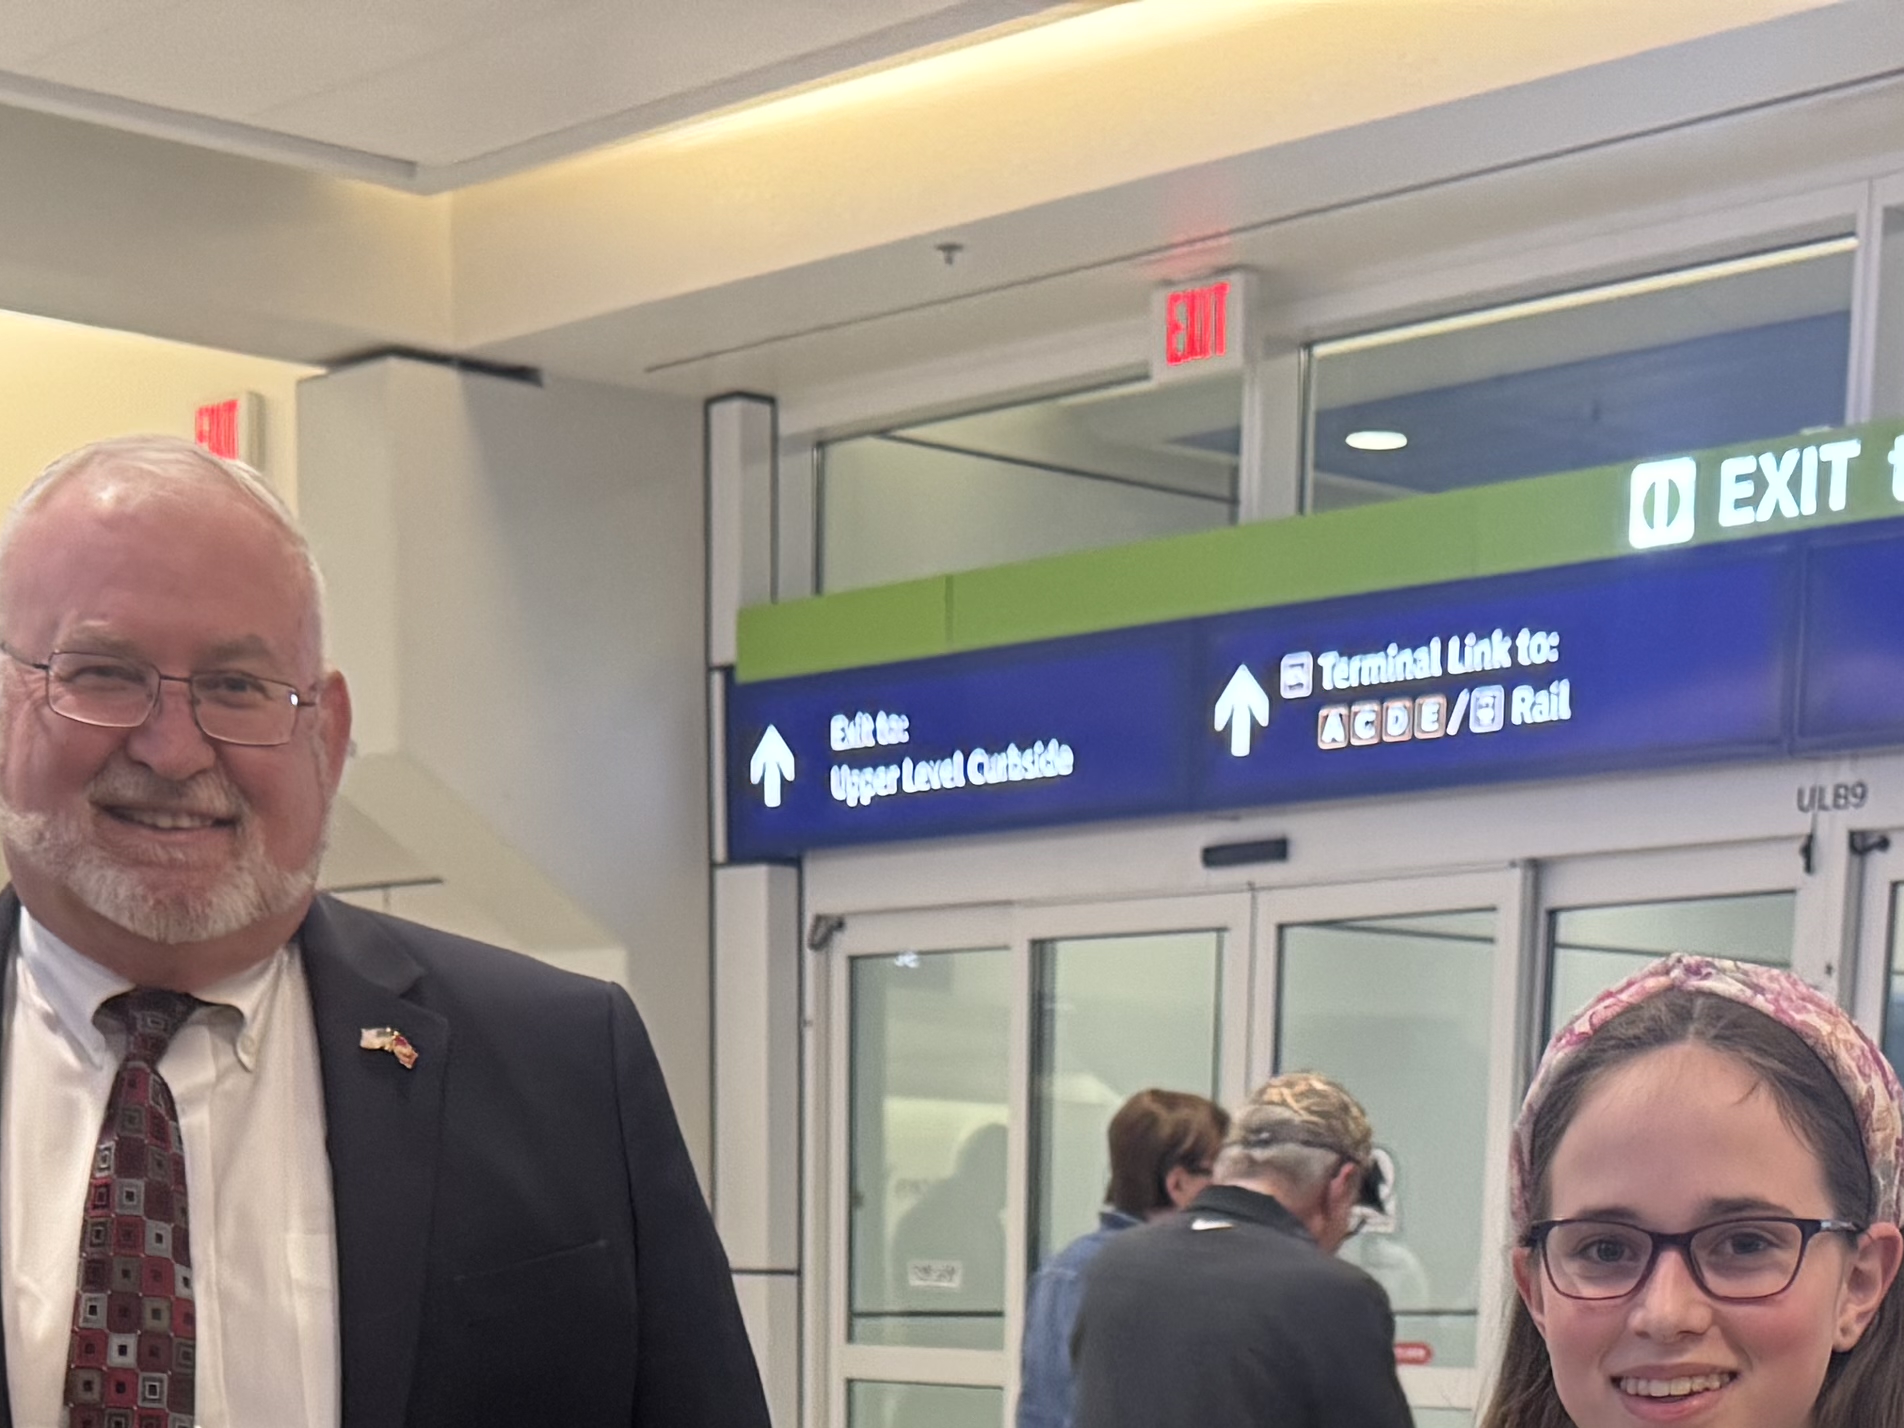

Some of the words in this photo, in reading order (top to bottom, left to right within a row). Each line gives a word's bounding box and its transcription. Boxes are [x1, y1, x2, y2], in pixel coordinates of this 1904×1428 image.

[1166, 281, 1231, 366] EXIT
[1718, 438, 1862, 527] EXIT
[1317, 635, 1443, 691] Terminal
[1447, 627, 1512, 675] Link
[1515, 627, 1560, 667] to:
[830, 710, 876, 752] Exit
[1321, 711, 1346, 744] A
[1353, 708, 1377, 740] C
[1419, 699, 1441, 733] E
[1510, 678, 1572, 726] Rail
[830, 764, 901, 808] Upper
[902, 750, 966, 794] Level
[967, 738, 1075, 786] Curbside
[1797, 781, 1869, 813] ULB9
